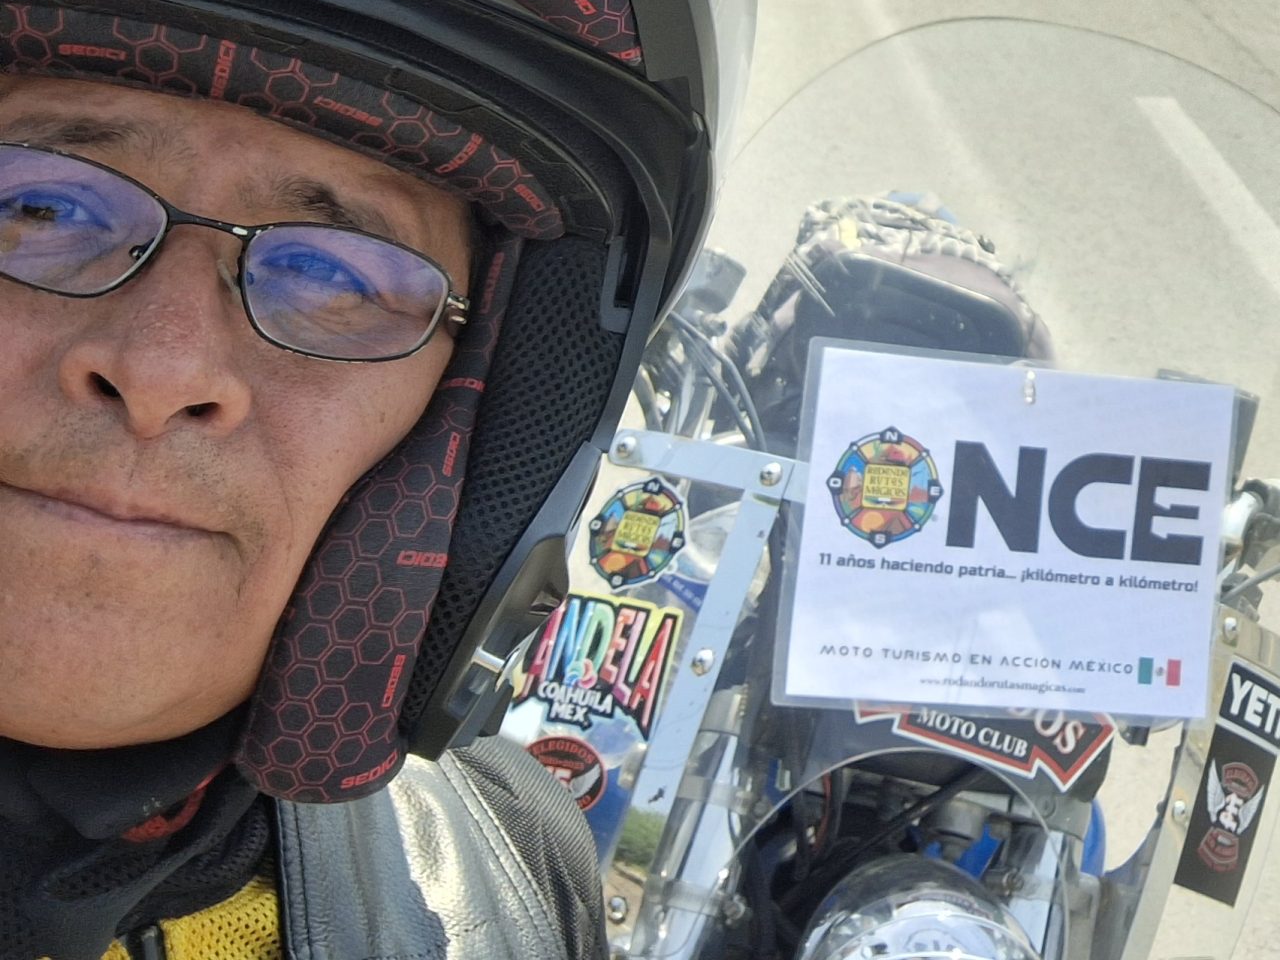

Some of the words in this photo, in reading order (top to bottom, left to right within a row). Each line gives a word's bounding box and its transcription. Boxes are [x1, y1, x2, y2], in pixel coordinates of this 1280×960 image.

[58, 43, 128, 61] SEDICI
[313, 95, 383, 127] SEDICI
[396, 550, 448, 568] EDICI
[819, 553, 832, 565] 11
[836, 554, 876, 569] años
[880, 557, 953, 574] haciendo
[1105, 576, 1114, 586] a
[1119, 575, 1199, 592] kilómetro!
[514, 596, 675, 727] ANDELA
[819, 644, 873, 658] MOTO
[881, 648, 962, 663] TURISMO
[969, 654, 992, 666] EN
[381, 654, 406, 708] SEDICI
[919, 675, 1086, 694] www.rodandorutasmagicas.com
[537, 681, 614, 714] COAHUILA
[916, 707, 976, 739] MOTO
[979, 727, 1028, 758] CLUB
[532, 740, 596, 763] ELEGIDOS
